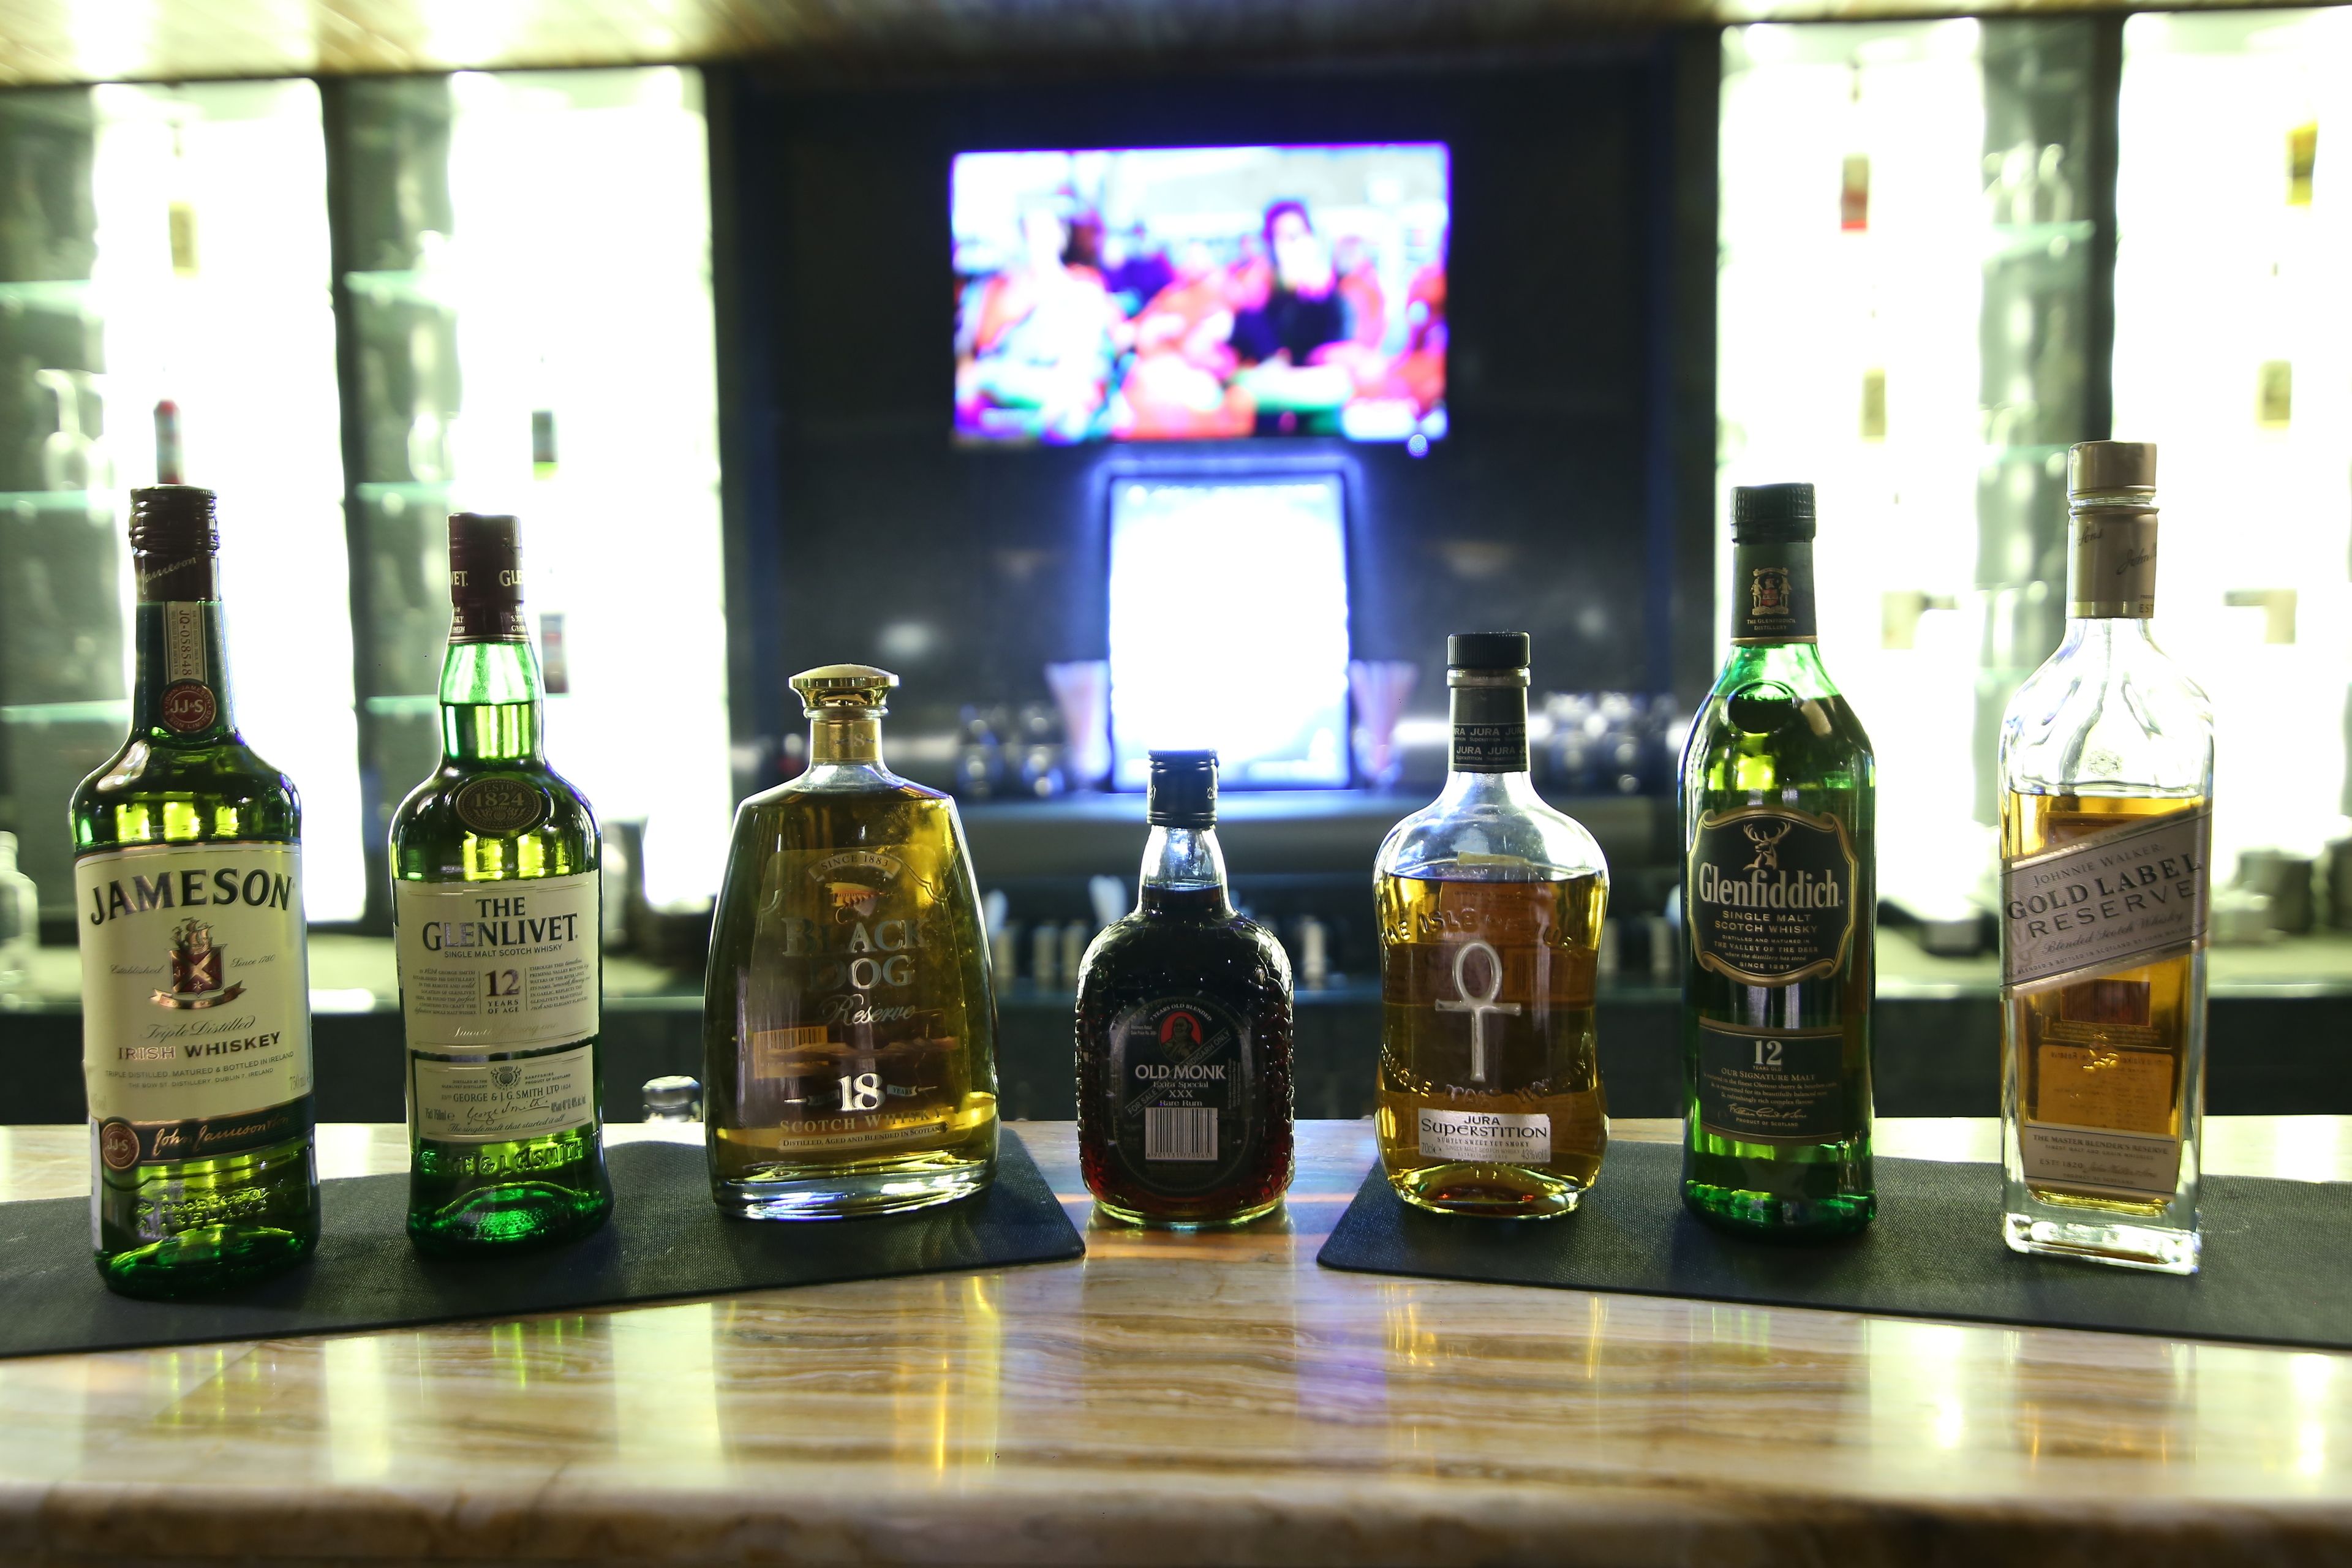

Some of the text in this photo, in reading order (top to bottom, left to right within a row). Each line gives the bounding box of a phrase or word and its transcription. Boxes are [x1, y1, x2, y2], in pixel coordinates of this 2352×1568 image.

[141, 557, 196, 595] Jameson
[179, 610, 192, 676] JQ-058548
[170, 699, 204, 713] JJ&S
[1505, 726, 1525, 736] JURA
[1457, 745, 1482, 755] JURA
[475, 792, 524, 807] 1824
[821, 855, 889, 870] SINCE 1883
[2033, 843, 2160, 888] JOHNNIE WALKER
[1699, 861, 1840, 909] Glenfiddich
[2007, 853, 2202, 921] GOLD LABEL
[91, 868, 293, 925] JAMESON
[475, 896, 526, 918] THE
[1722, 910, 1811, 922] SINGLE MALT
[2027, 879, 2196, 938] RESERVE
[1715, 920, 1818, 933] SCOTCH WHISKY
[781, 916, 932, 957] BLACK
[1714, 940, 1727, 949] THE
[1729, 943, 1760, 952] VALLEY
[2041, 931, 2095, 954] Blended
[2095, 921, 2135, 942] Scotch
[444, 950, 473, 959] SINGLE
[499, 948, 532, 957] SCOTCH
[534, 943, 563, 954] WHISKY
[2018, 962, 2046, 974] BLENDED
[2056, 952, 2084, 965] BOTTLED
[2095, 941, 2131, 955] SCOTLAND
[230, 954, 277, 968] Since 1780
[484, 968, 521, 997] 12
[807, 954, 916, 993] DOG
[819, 993, 918, 1027] Reserve
[1153, 1006, 1170, 1018] YEARS
[1186, 1004, 1213, 1022] BLENDED
[139, 1015, 255, 1042] Triple Distilled
[119, 1031, 281, 1061] IRISH WHISKEY
[1754, 1040, 1783, 1066] 12
[173, 1068, 213, 1077] MATURED
[224, 1060, 258, 1071] BOTTLED
[269, 1051, 295, 1063] IRELAND
[1128, 1030, 1231, 1115] FOR SALE ONLY
[1135, 1065, 1227, 1080] OLD MONK
[215, 1074, 241, 1083] DUBLIN
[248, 1068, 274, 1077] IRELAND
[1178, 1080, 1209, 1089] Special
[1721, 1068, 1738, 1077] OUR
[1740, 1071, 1789, 1082] SIGNATURE
[453, 1093, 488, 1102] GEORGE
[516, 1087, 543, 1099] SMITH
[835, 1072, 886, 1112] 18
[892, 1086, 914, 1095] YEARS
[1169, 1090, 1194, 1098] XXX
[1727, 1093, 1756, 1104] refreshingly
[448, 1123, 461, 1132] The
[521, 1117, 548, 1128] started
[554, 1113, 566, 1122] all
[467, 1106, 499, 1126] George
[780, 1106, 944, 1133] SCOTCH WHISKY
[1463, 1115, 1501, 1126] JURA
[782, 1139, 824, 1148] DISTILLED,
[864, 1131, 900, 1142] BLENDED
[910, 1125, 946, 1136] SCOTLAND
[2033, 1134, 2130, 1150] THE MASTER BLENDER'S
[2062, 1159, 2084, 1169] 1820
